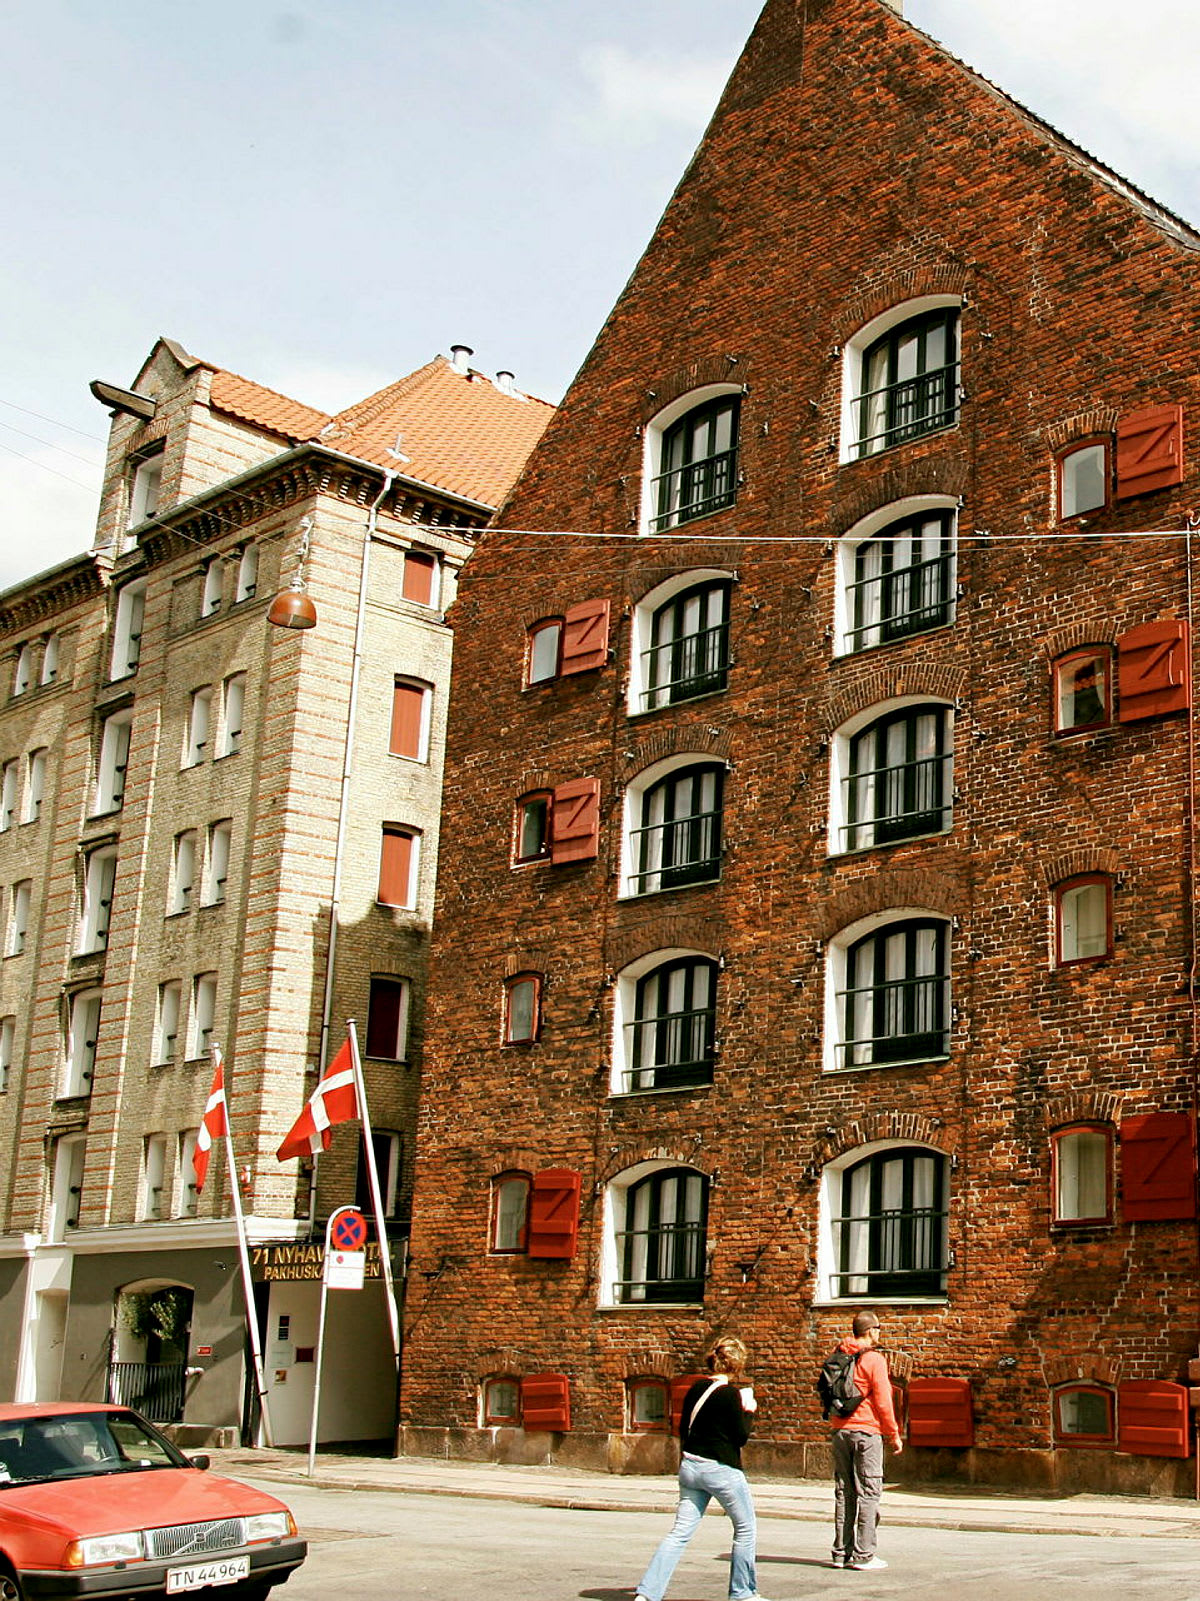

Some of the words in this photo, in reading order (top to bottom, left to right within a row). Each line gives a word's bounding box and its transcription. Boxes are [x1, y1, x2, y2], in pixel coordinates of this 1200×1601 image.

[253, 1248, 269, 1265] 71
[274, 1245, 326, 1264] NYHAV
[170, 1570, 195, 1587] TN
[198, 1566, 216, 1581] 44
[220, 1561, 246, 1578] 964
